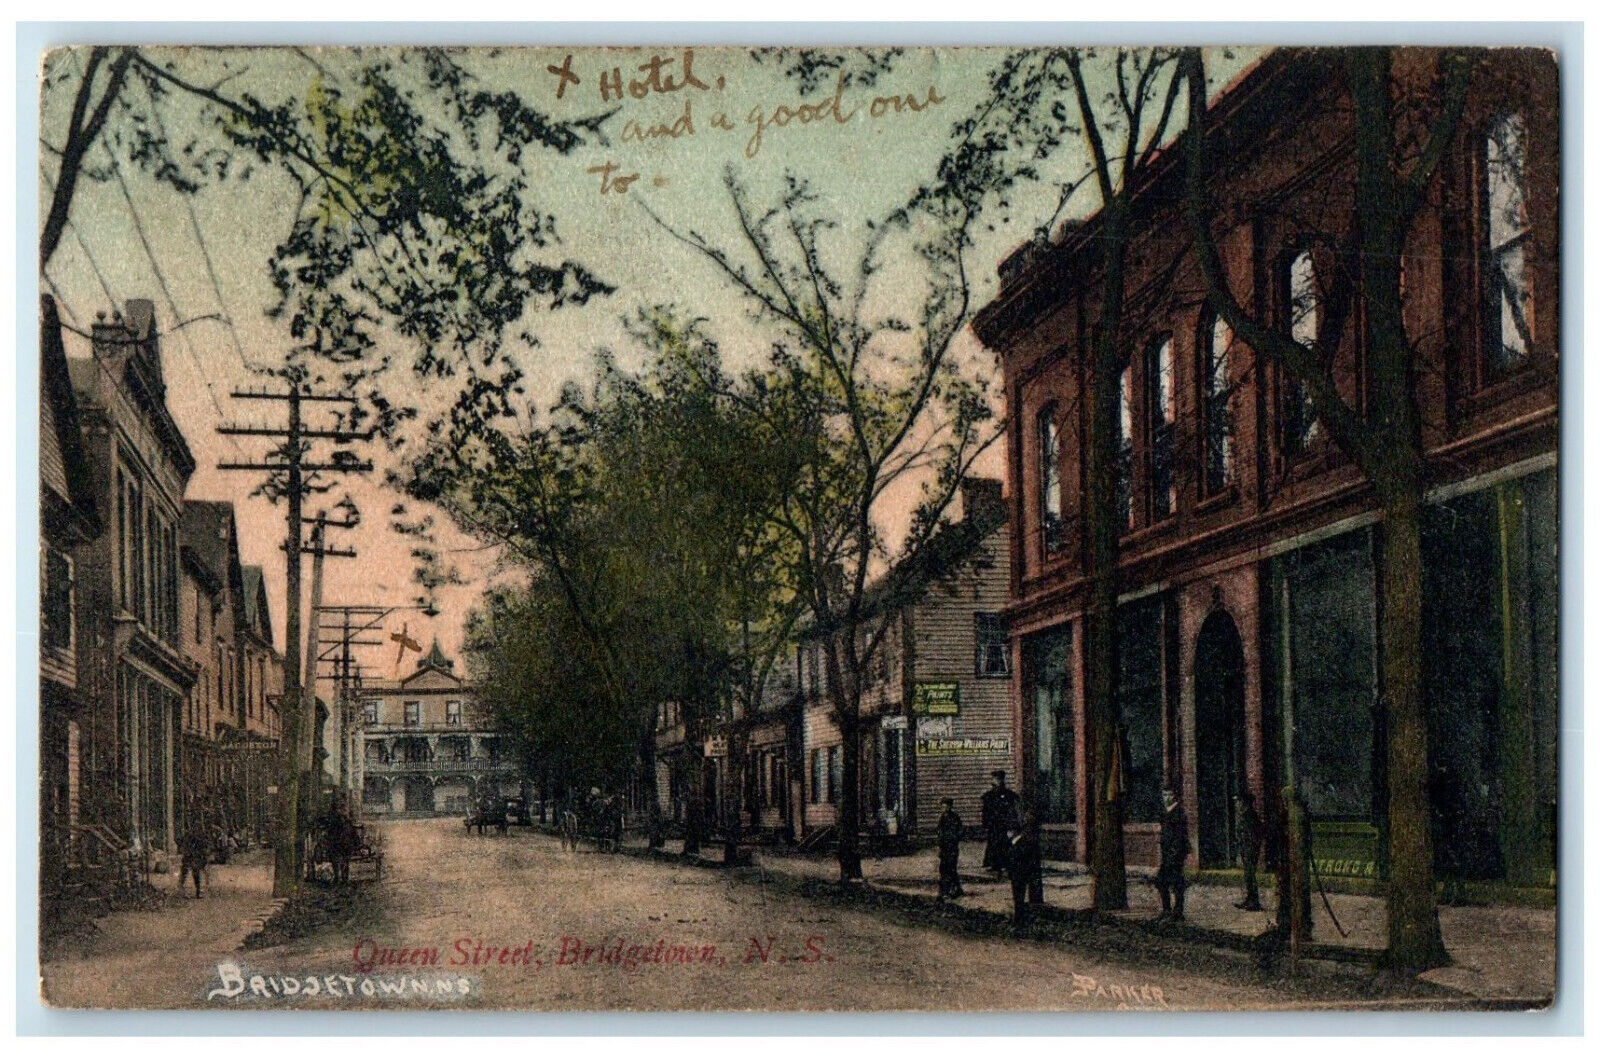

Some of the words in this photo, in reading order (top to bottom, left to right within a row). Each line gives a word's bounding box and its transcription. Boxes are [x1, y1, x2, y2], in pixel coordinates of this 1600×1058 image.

[621, 99, 695, 142] and
[710, 113, 735, 131] a
[745, 69, 857, 158] good
[870, 85, 945, 118] one
